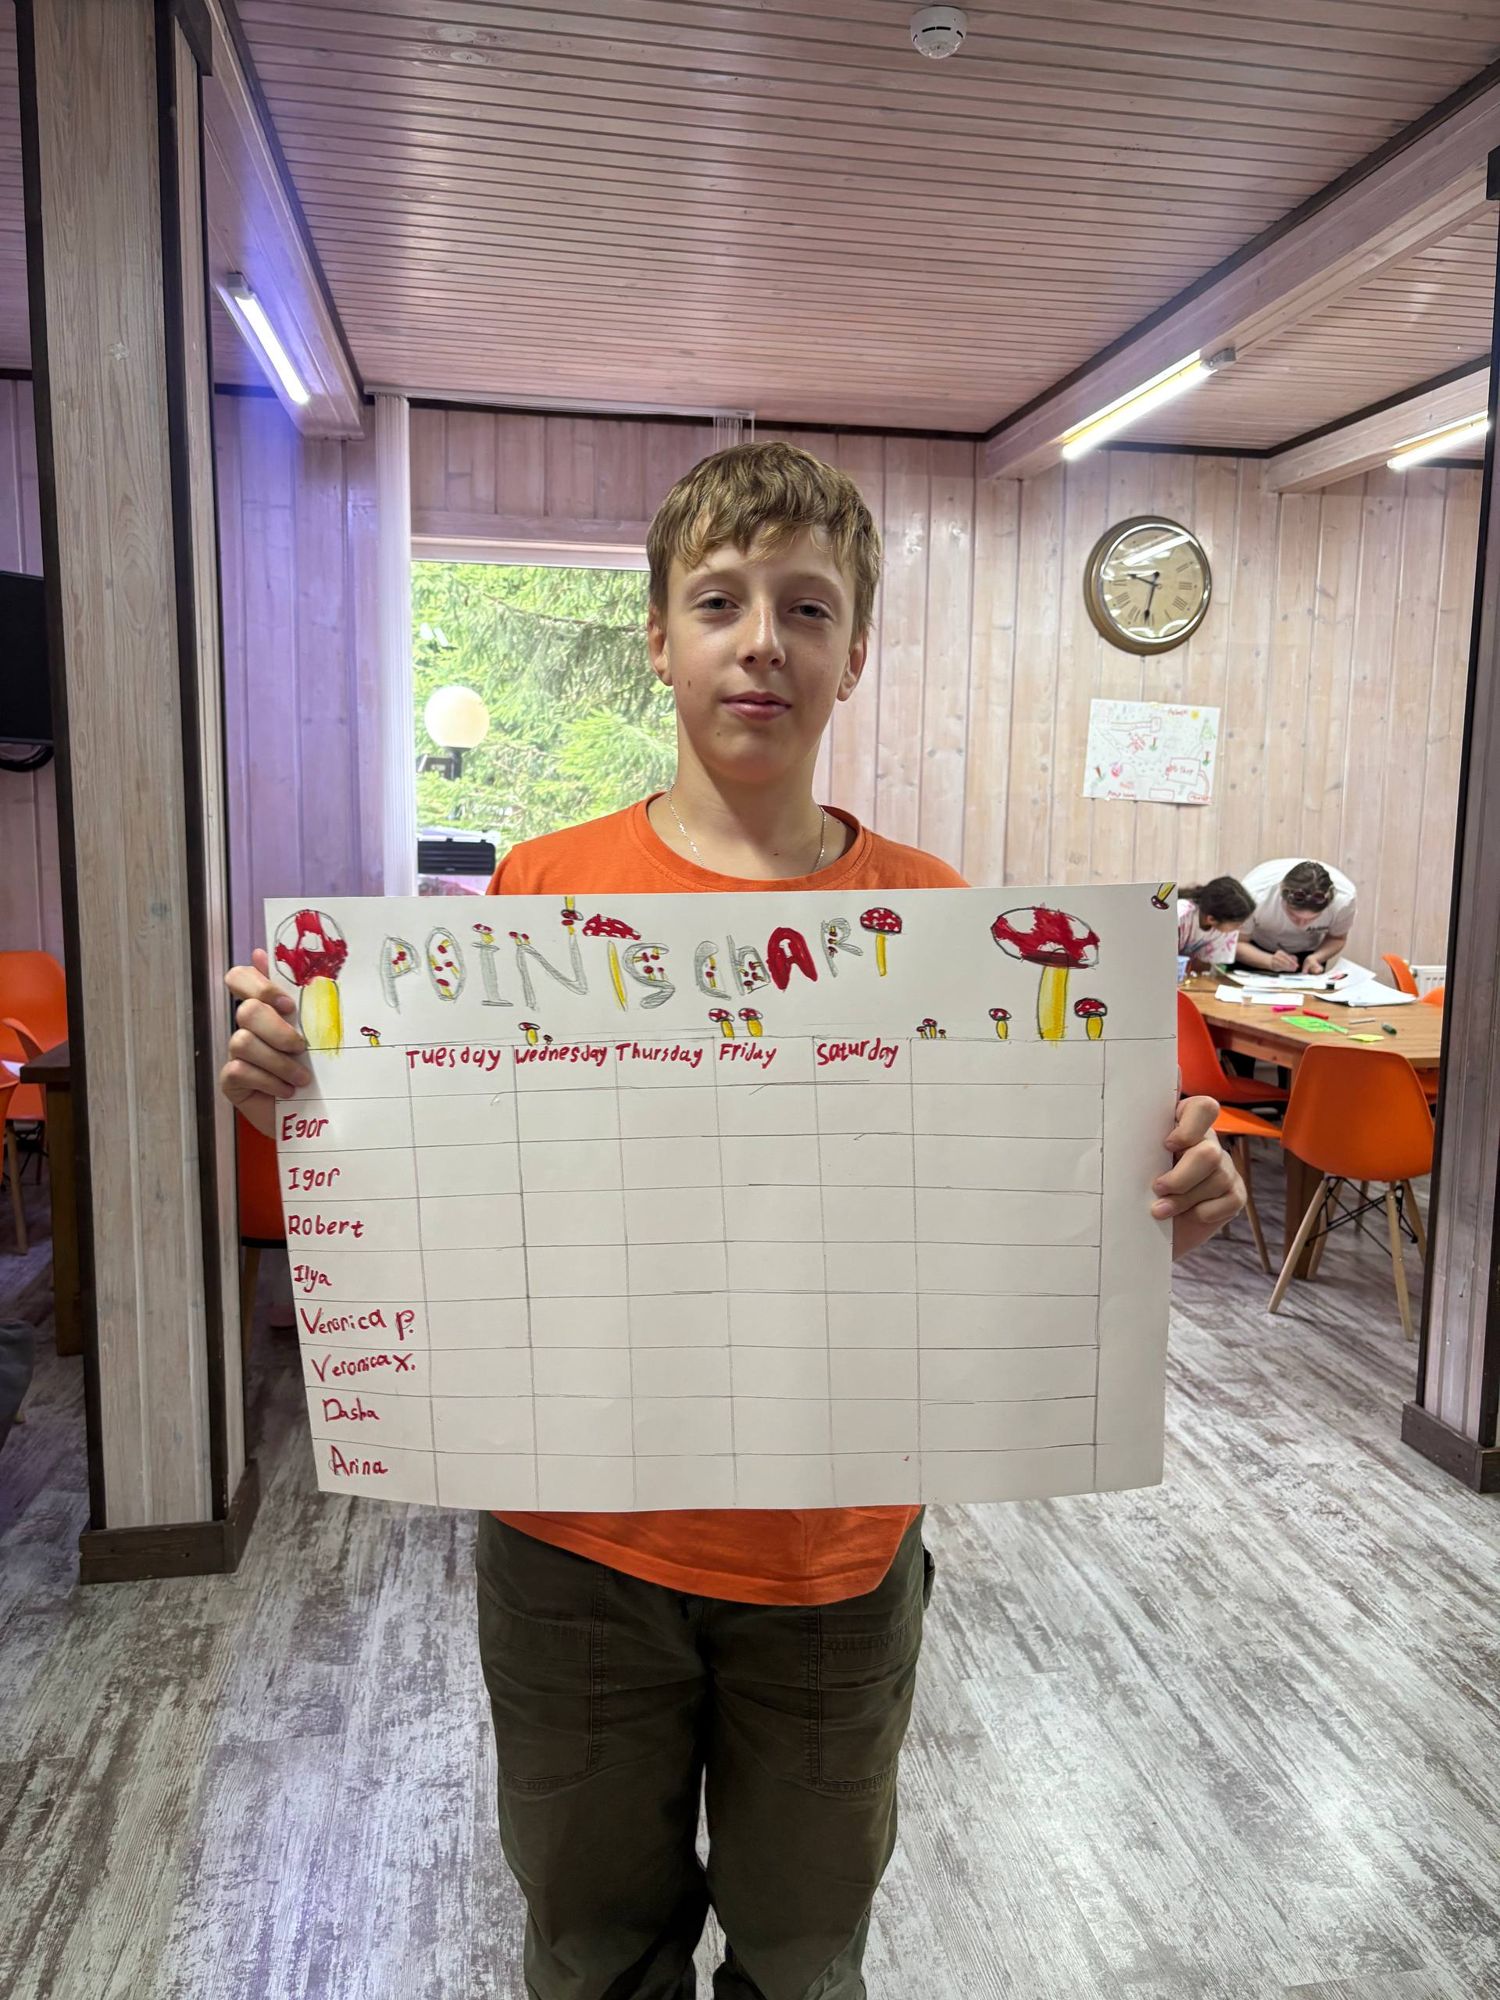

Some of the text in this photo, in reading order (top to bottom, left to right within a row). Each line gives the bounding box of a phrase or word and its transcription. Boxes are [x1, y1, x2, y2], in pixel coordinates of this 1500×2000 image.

[405, 1046, 501, 1072] Tuesday
[513, 1045, 608, 1068] Wednesday
[615, 1041, 703, 1069] Thursday
[719, 1042, 777, 1070] Friday
[280, 1112, 329, 1143] Egor
[288, 1167, 340, 1192] Igor
[287, 1215, 363, 1239] Robert
[293, 1264, 332, 1294] Ilya
[299, 1308, 388, 1335] Veronica
[311, 1354, 392, 1382] Veronica
[322, 1397, 381, 1422] Dasha
[330, 1445, 388, 1476] Arina
